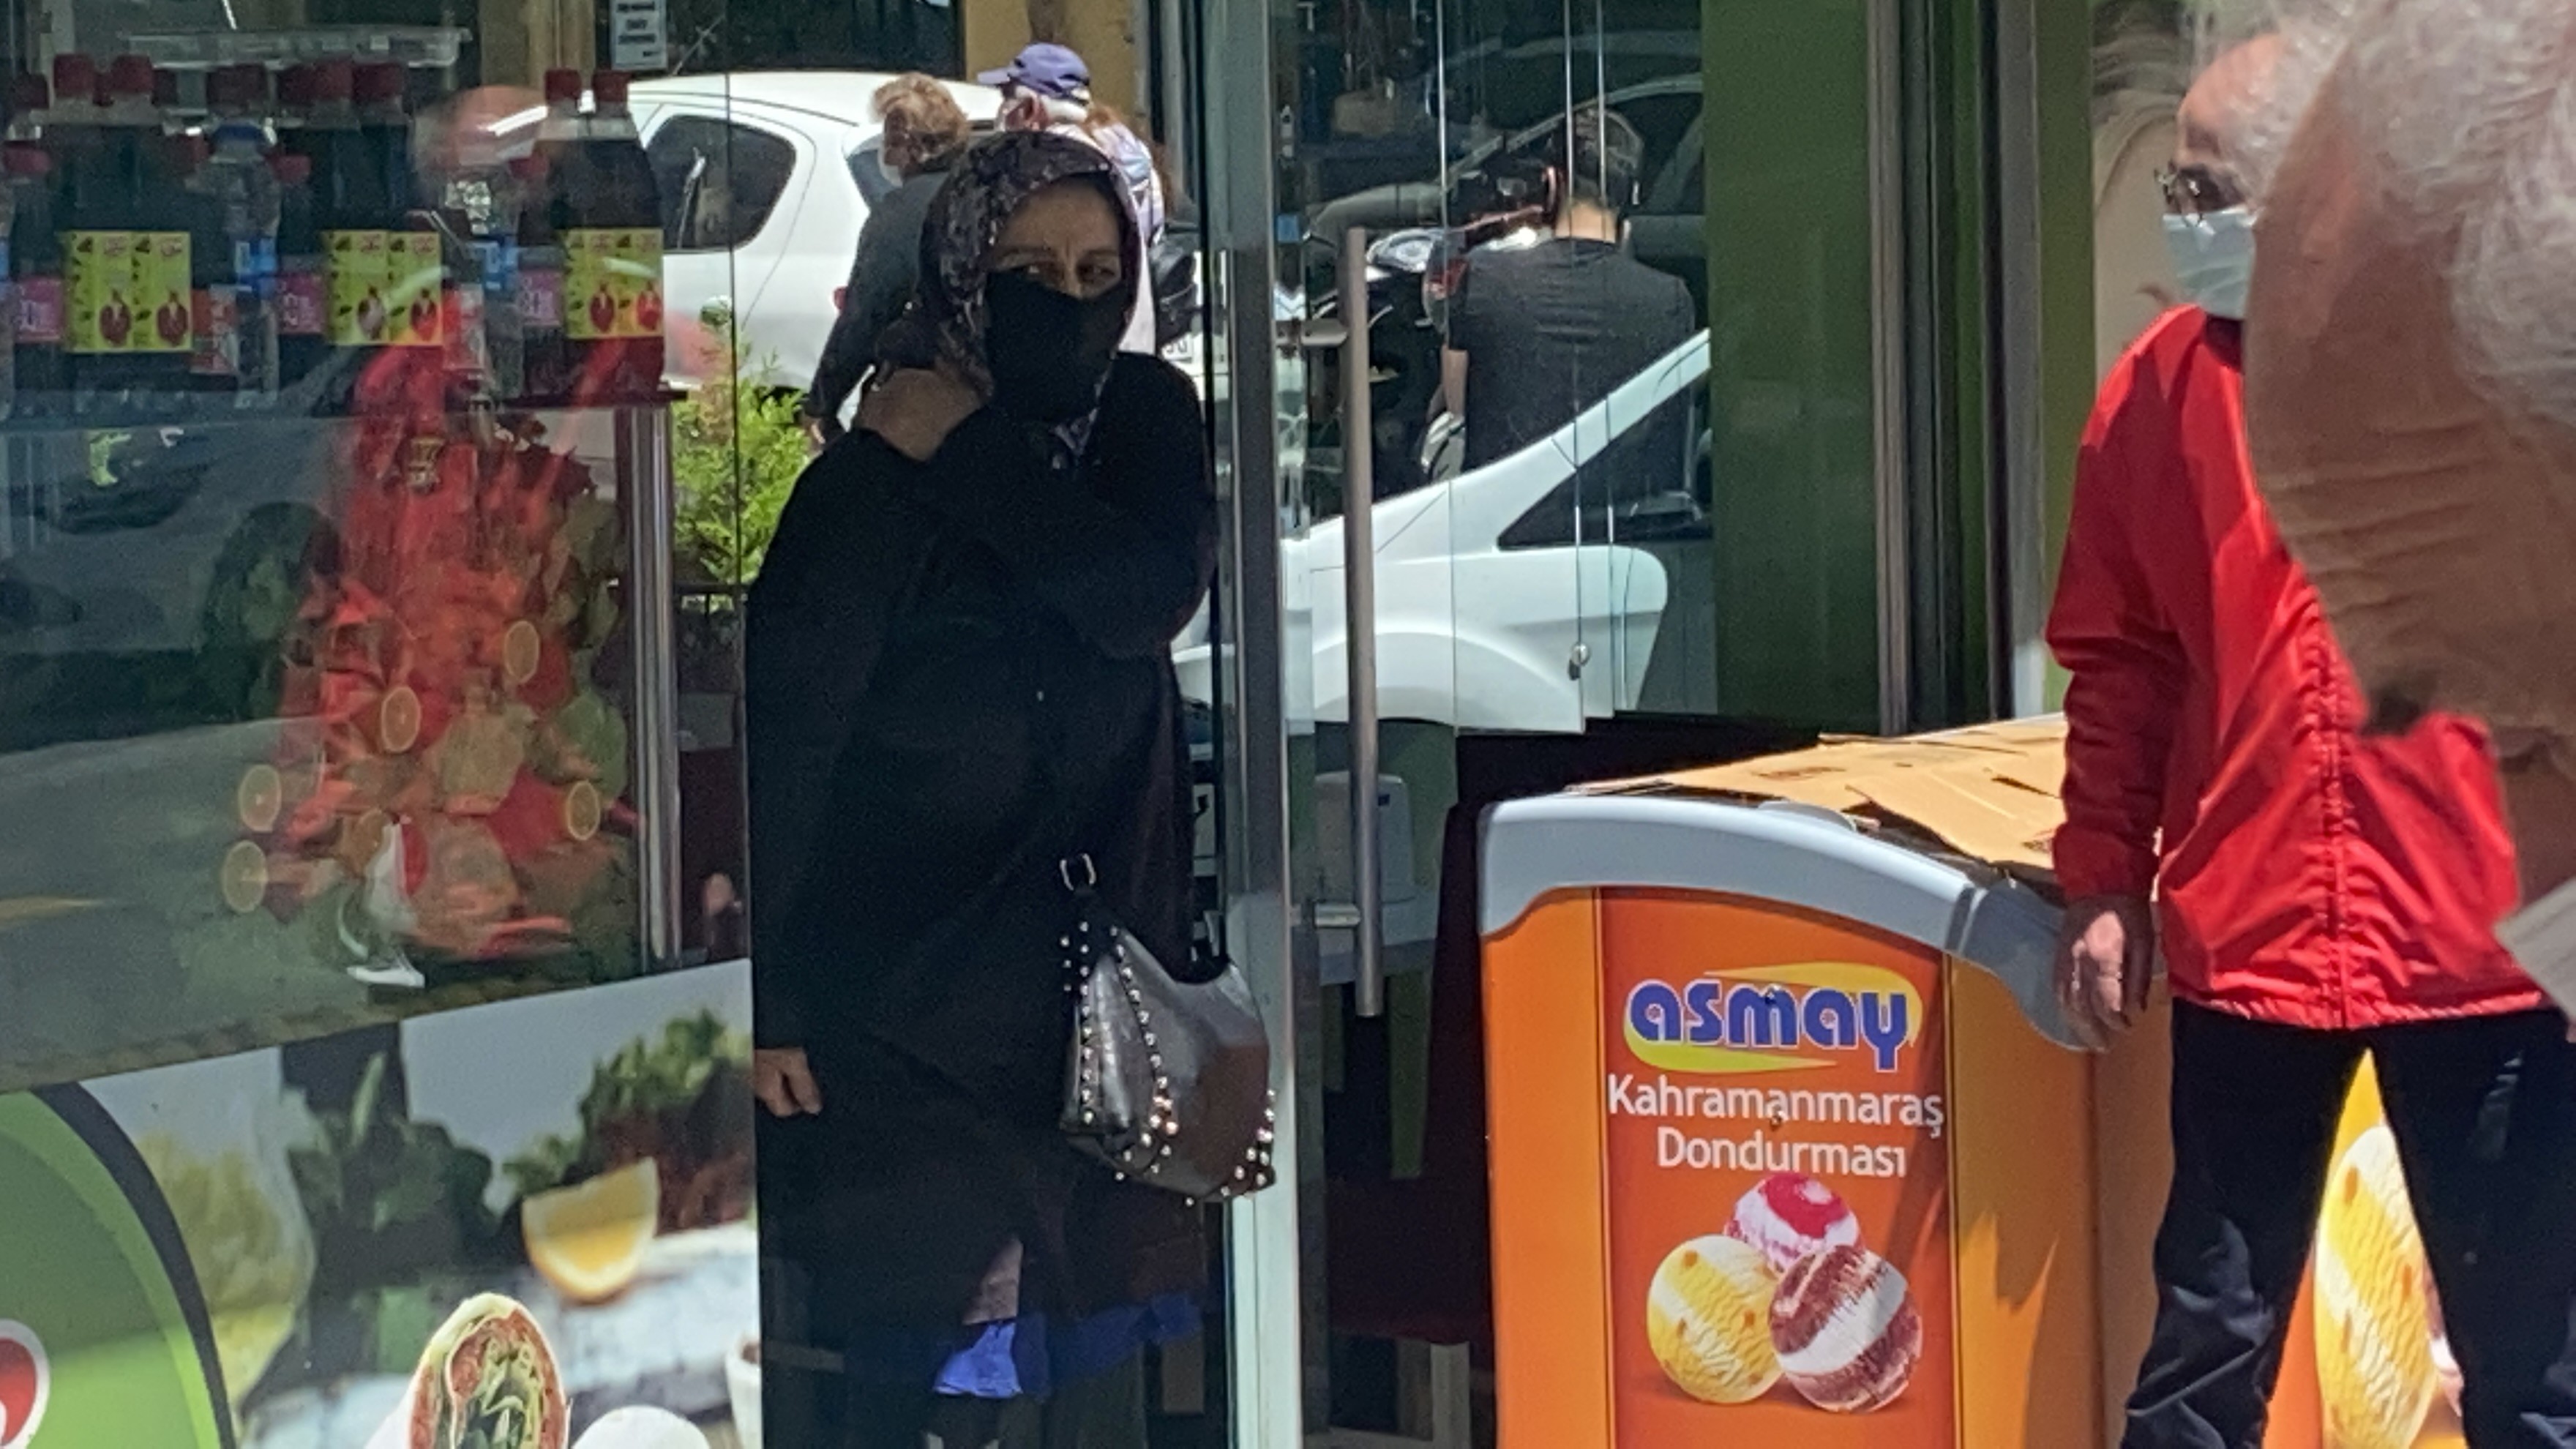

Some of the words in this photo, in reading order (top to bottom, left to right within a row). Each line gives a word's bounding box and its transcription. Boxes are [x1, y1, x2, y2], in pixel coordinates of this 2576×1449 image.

[1628, 978, 1909, 1072] asmay
[1608, 1073, 1944, 1139] Kahramanmaraş
[1658, 1126, 1906, 1177] Dondurması
